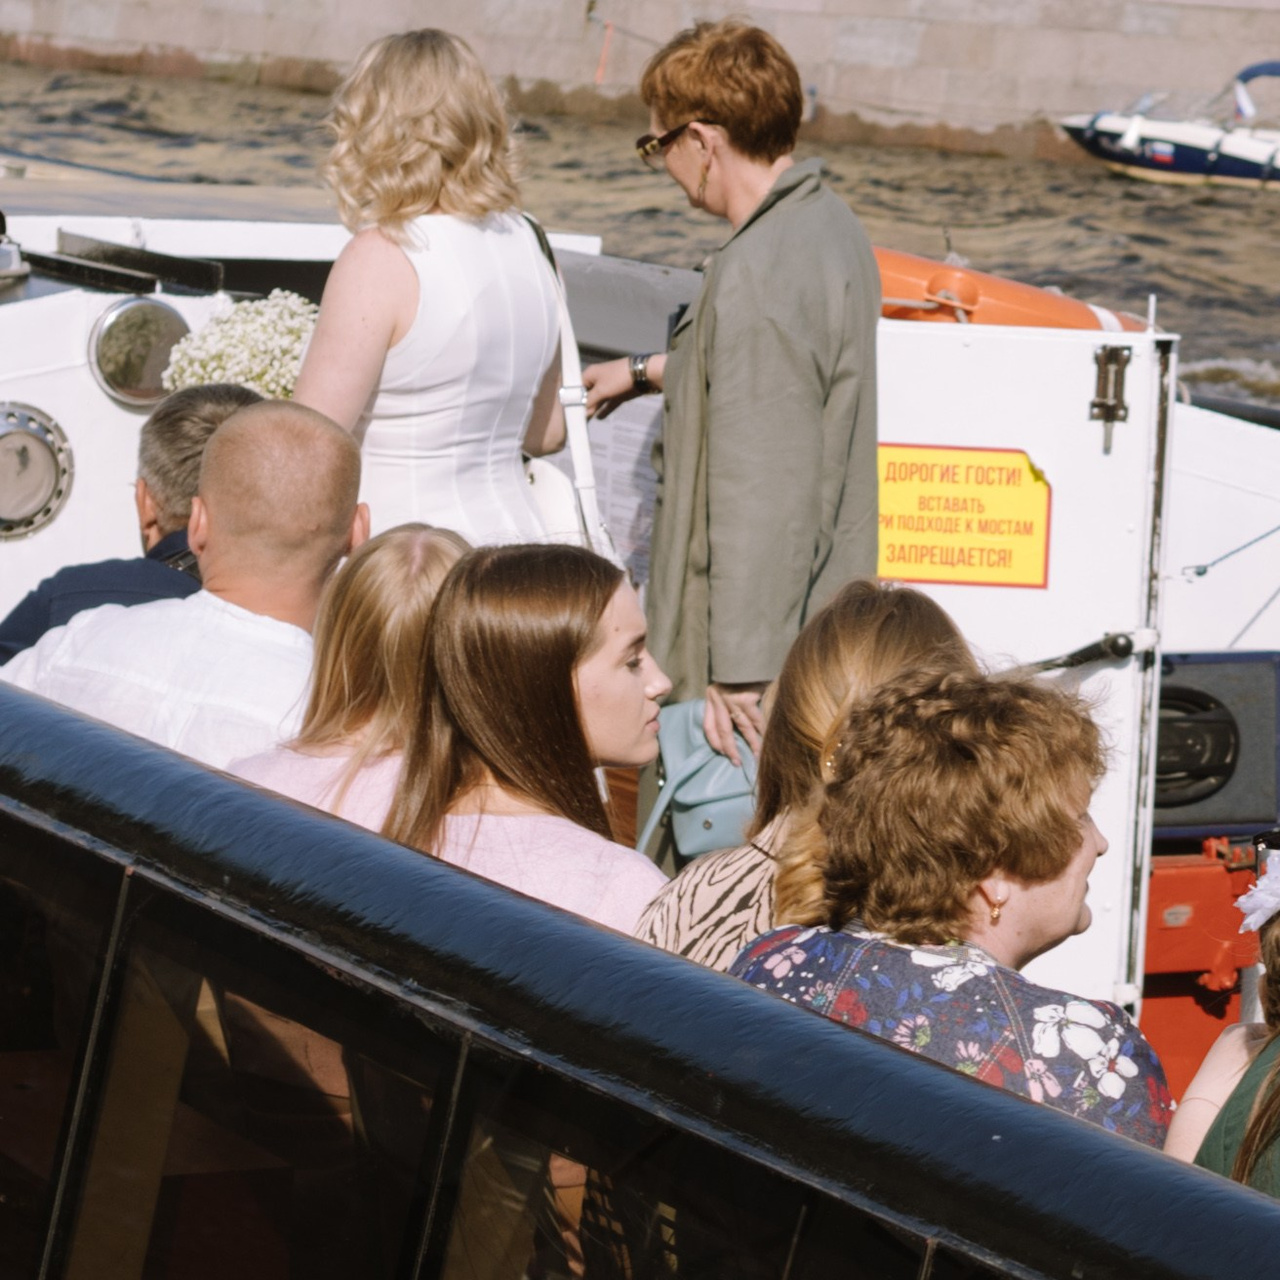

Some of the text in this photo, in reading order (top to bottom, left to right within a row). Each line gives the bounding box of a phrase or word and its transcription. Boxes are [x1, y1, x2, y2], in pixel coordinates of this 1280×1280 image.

[885, 462, 1022, 486] ДОРОГИЕ ГОСТИ!
[918, 496, 985, 513] ВСТАВАТЬ
[878, 513, 1034, 536] РИ ПОДХОДЕ К МОСТАМ
[886, 543, 1013, 568] ЗАПРЕЩАЕТСЯ!
